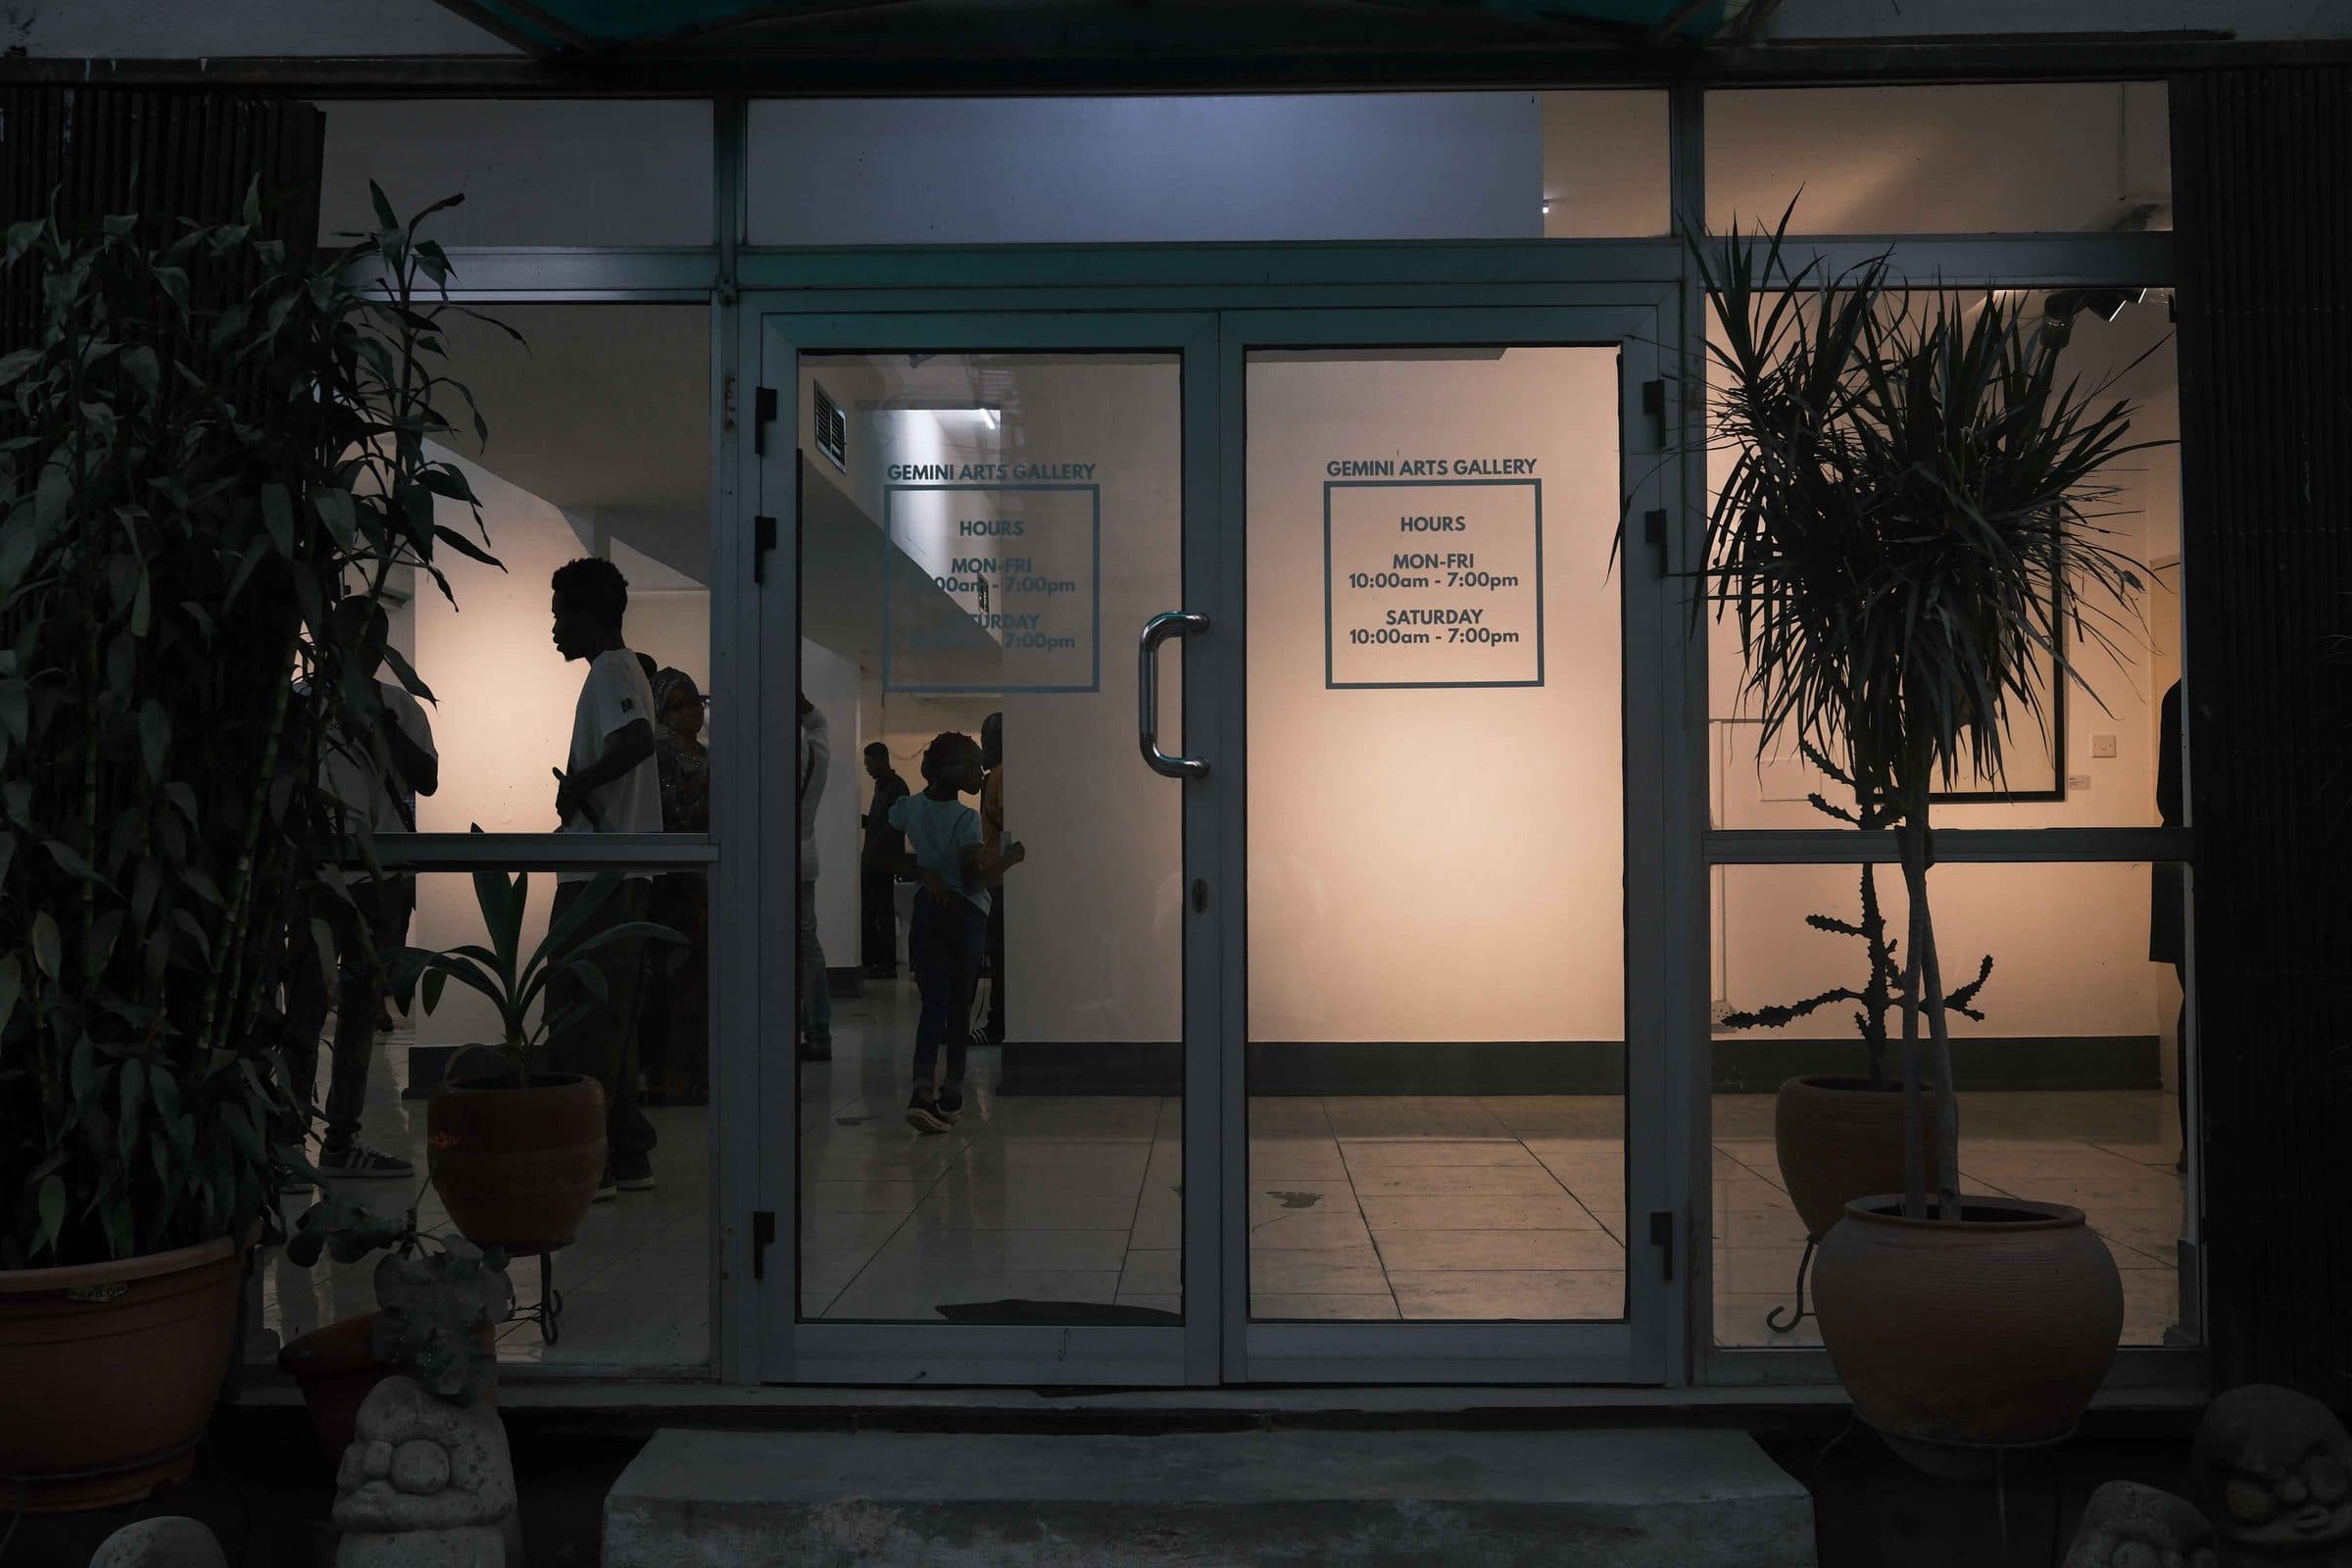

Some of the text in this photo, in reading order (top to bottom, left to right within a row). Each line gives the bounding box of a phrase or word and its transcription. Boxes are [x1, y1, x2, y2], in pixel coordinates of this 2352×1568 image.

[886, 464, 1096, 480] GEMINI ARTS GALLERY
[1326, 459, 1538, 476] GEMINI ARTS GALLERY
[959, 520, 1024, 537] HOURS
[1400, 516, 1466, 532] HOURS
[951, 558, 1032, 573] MON-FRI
[1393, 553, 1474, 569] MON-FRI
[1004, 575, 1076, 596] 7:00pm
[1348, 572, 1429, 589] 10:00am
[1446, 570, 1519, 591] 7:00pm
[1386, 609, 1484, 625] SATURDAY
[1004, 632, 1076, 652] 7:00pm
[1349, 628, 1430, 645] 10:00am
[1447, 626, 1520, 647] 7:00pm
